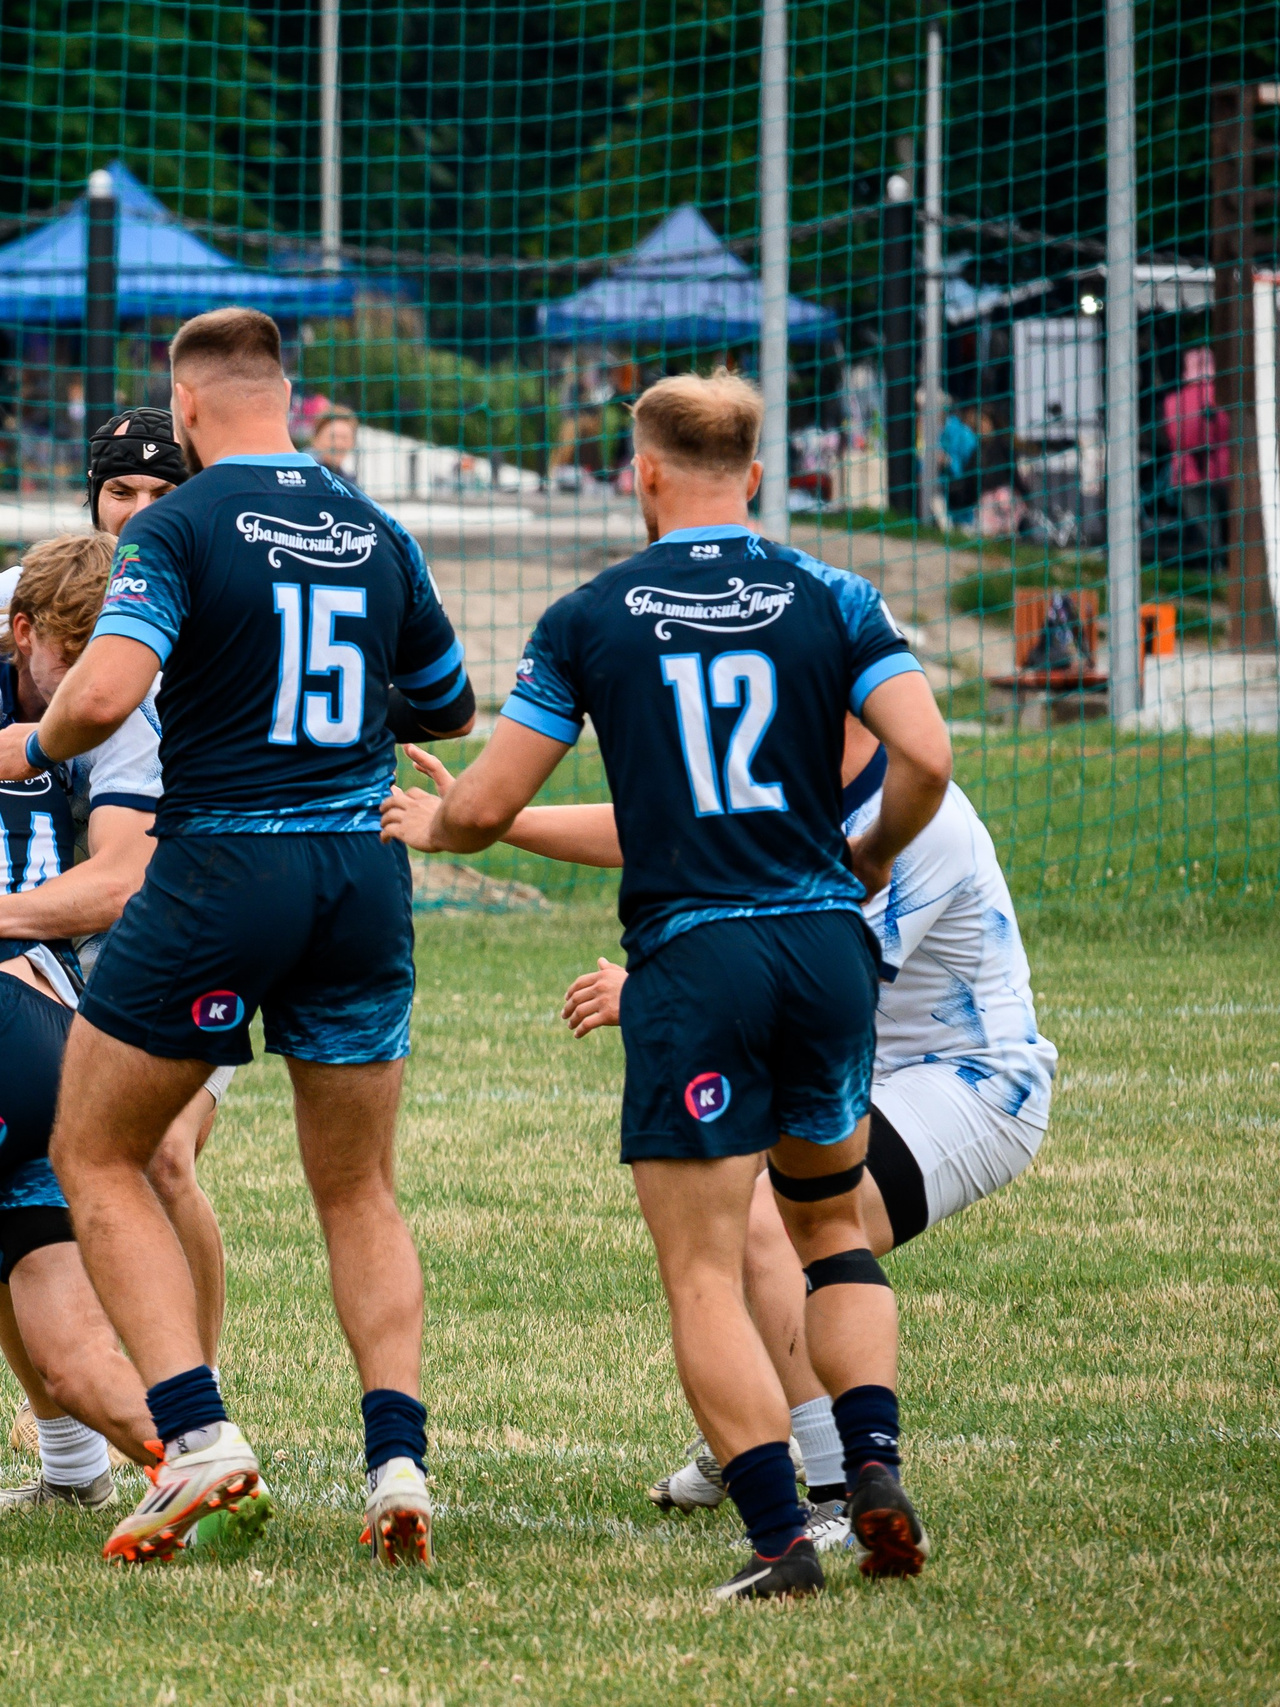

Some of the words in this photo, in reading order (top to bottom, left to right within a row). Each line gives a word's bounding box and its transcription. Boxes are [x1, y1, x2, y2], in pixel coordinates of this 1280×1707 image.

[236, 511, 334, 552] Балтийский
[331, 522, 378, 556] Парус
[625, 578, 743, 619] Балтийский
[739, 582, 795, 619] Парус
[268, 583, 368, 748] 15
[660, 650, 789, 818] 12
